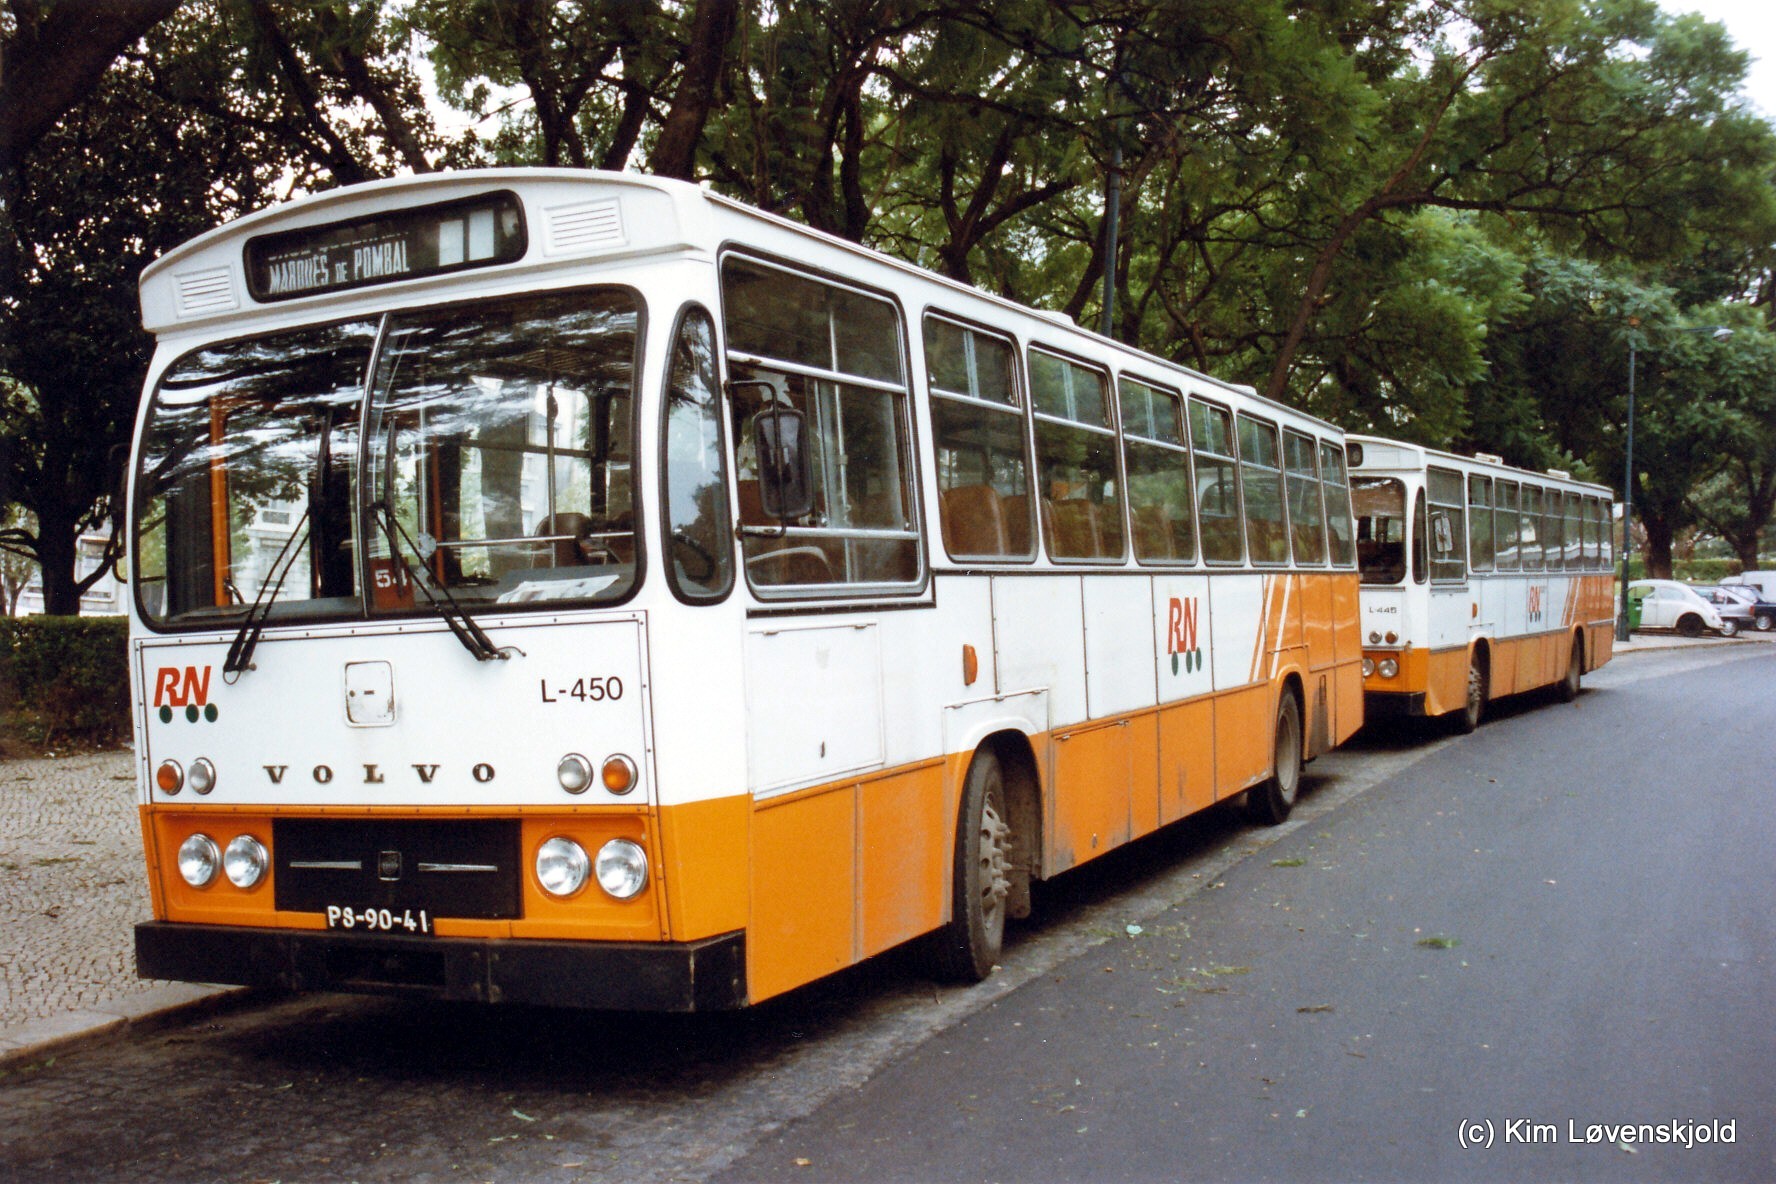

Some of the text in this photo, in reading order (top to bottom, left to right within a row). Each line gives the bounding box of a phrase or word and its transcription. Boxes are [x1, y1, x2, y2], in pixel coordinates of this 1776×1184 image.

[335, 261, 348, 283] DE
[354, 239, 410, 280] POMBAL
[1168, 597, 1197, 654] RN
[154, 665, 211, 707] RN
[541, 676, 623, 703] L-450
[263, 763, 495, 784] VOLVO
[327, 905, 428, 933] PS-90-41
